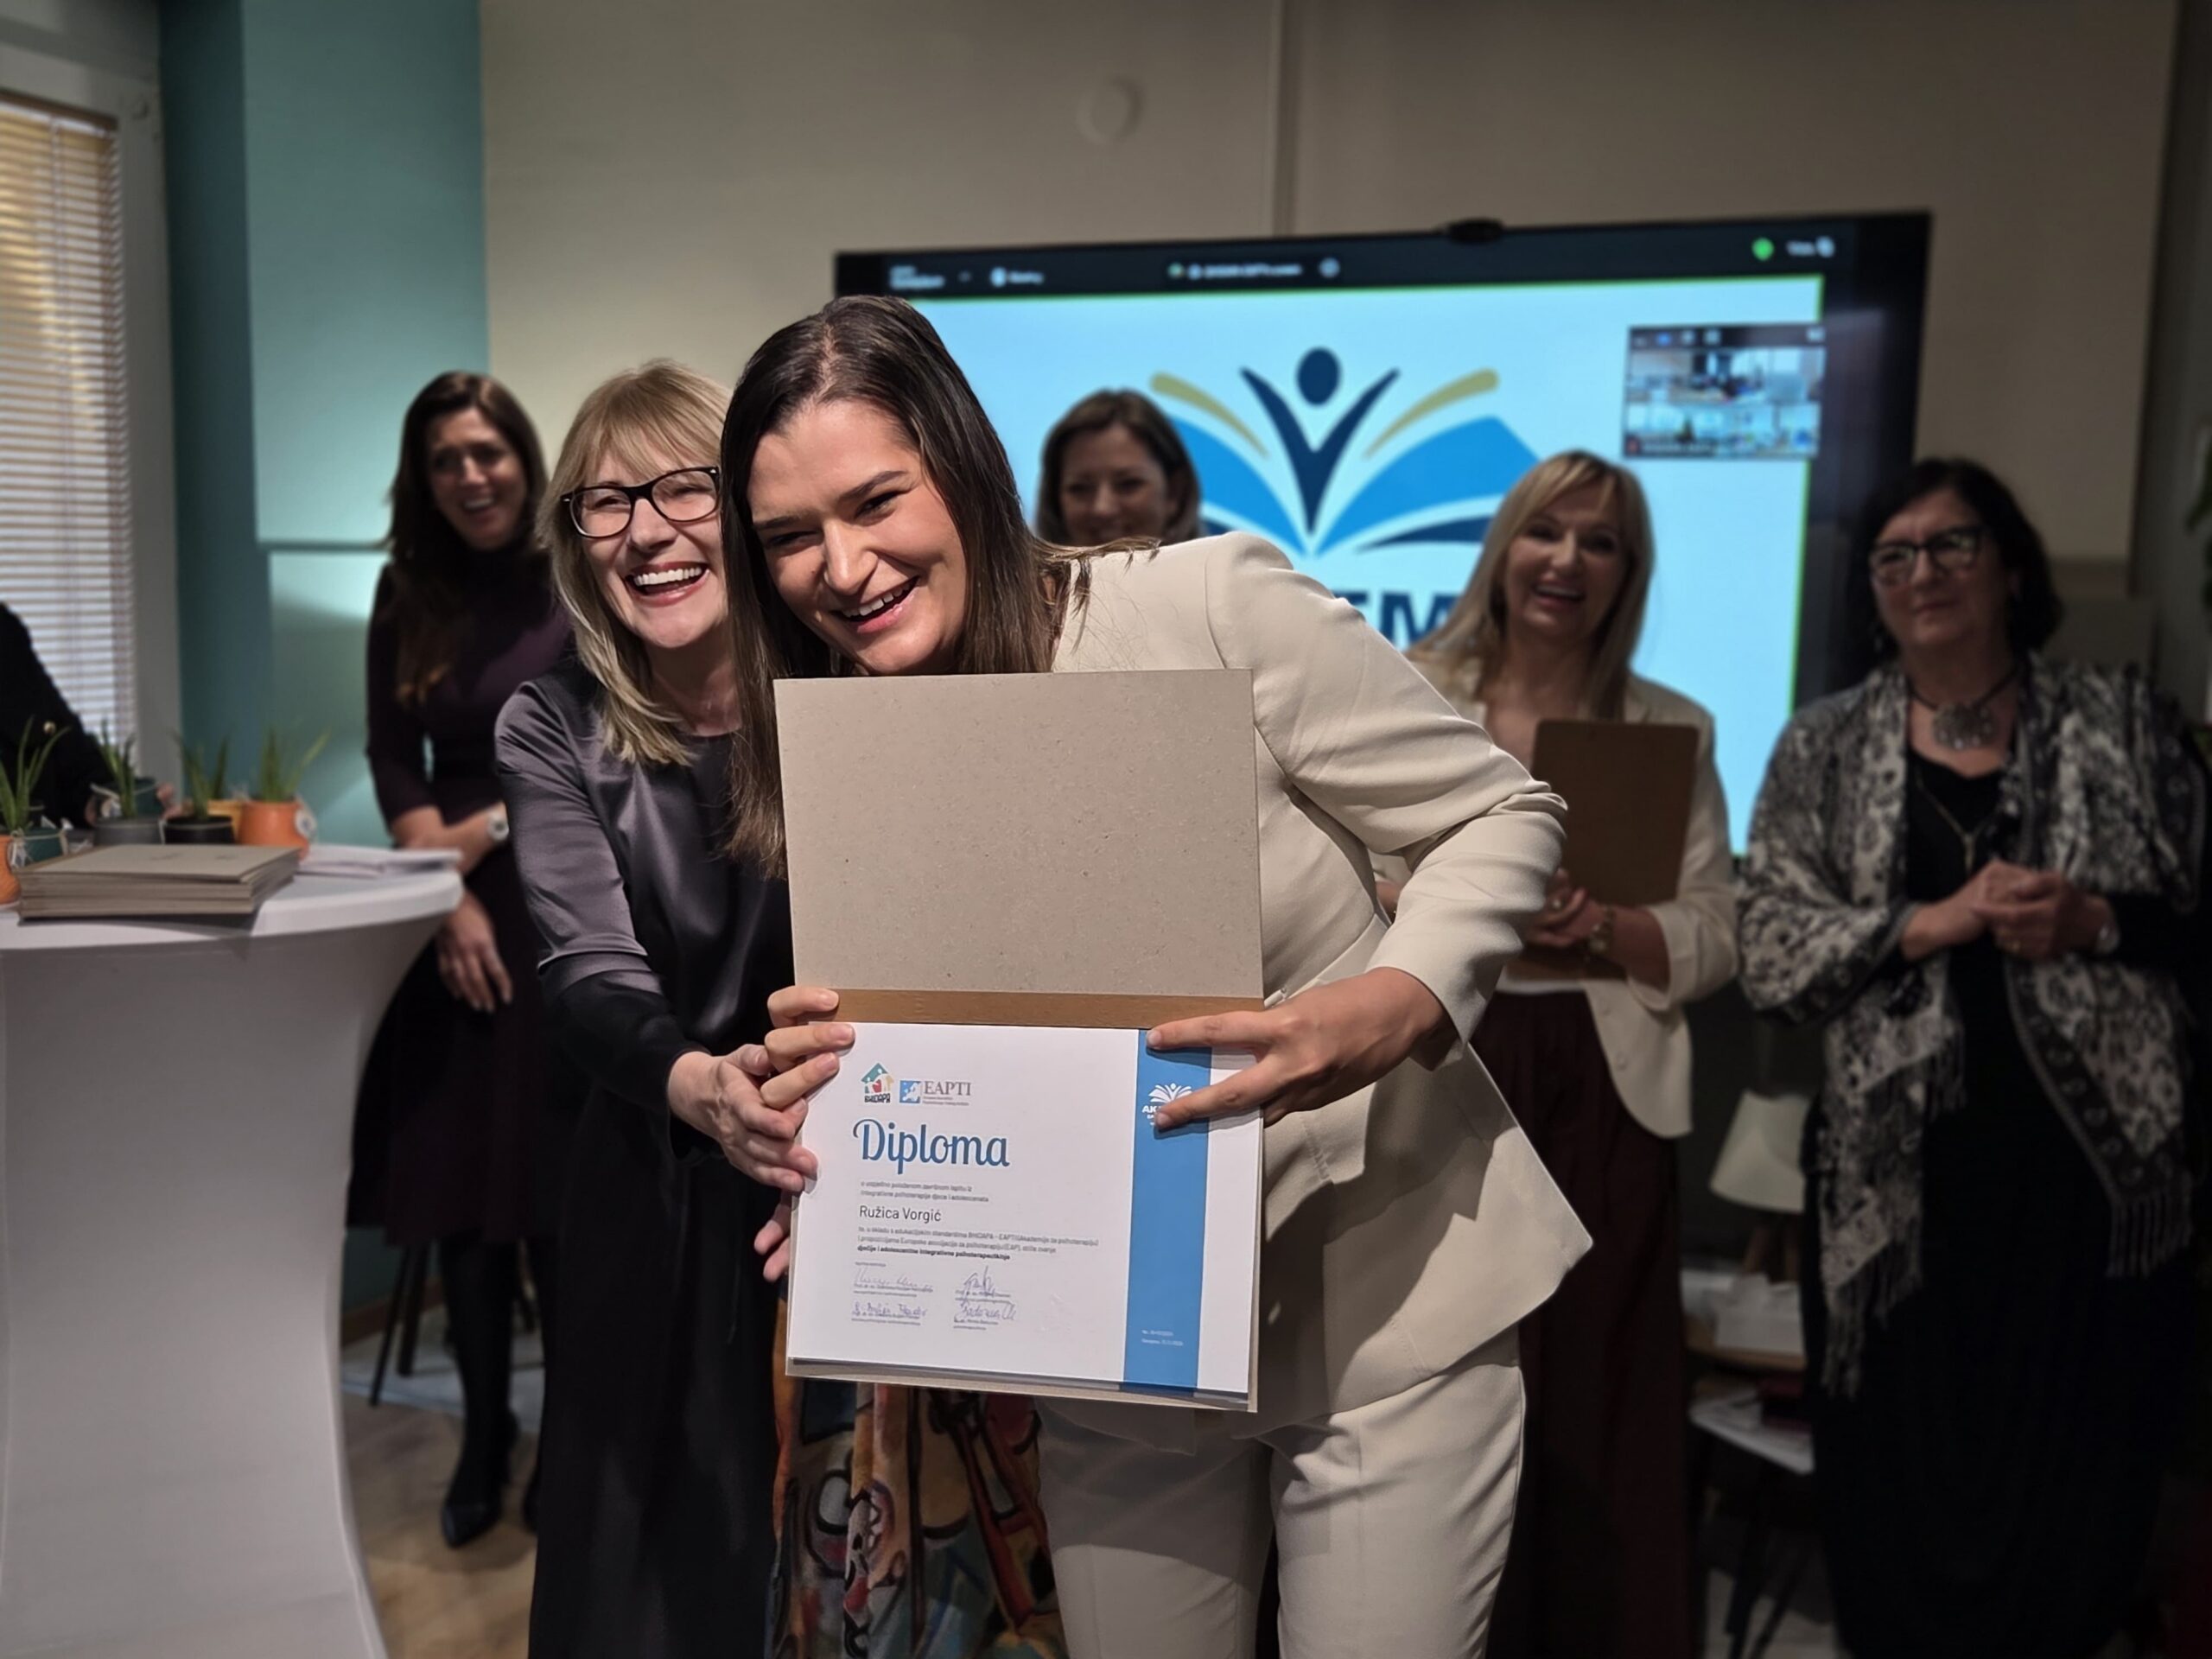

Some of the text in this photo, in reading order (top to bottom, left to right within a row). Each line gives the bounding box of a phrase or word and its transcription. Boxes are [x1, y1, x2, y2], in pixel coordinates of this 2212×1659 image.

[925, 1080, 971, 1096] EAPTI
[853, 1118, 1010, 1175] Diploma
[860, 1205, 942, 1224] Ružica Vorgić
